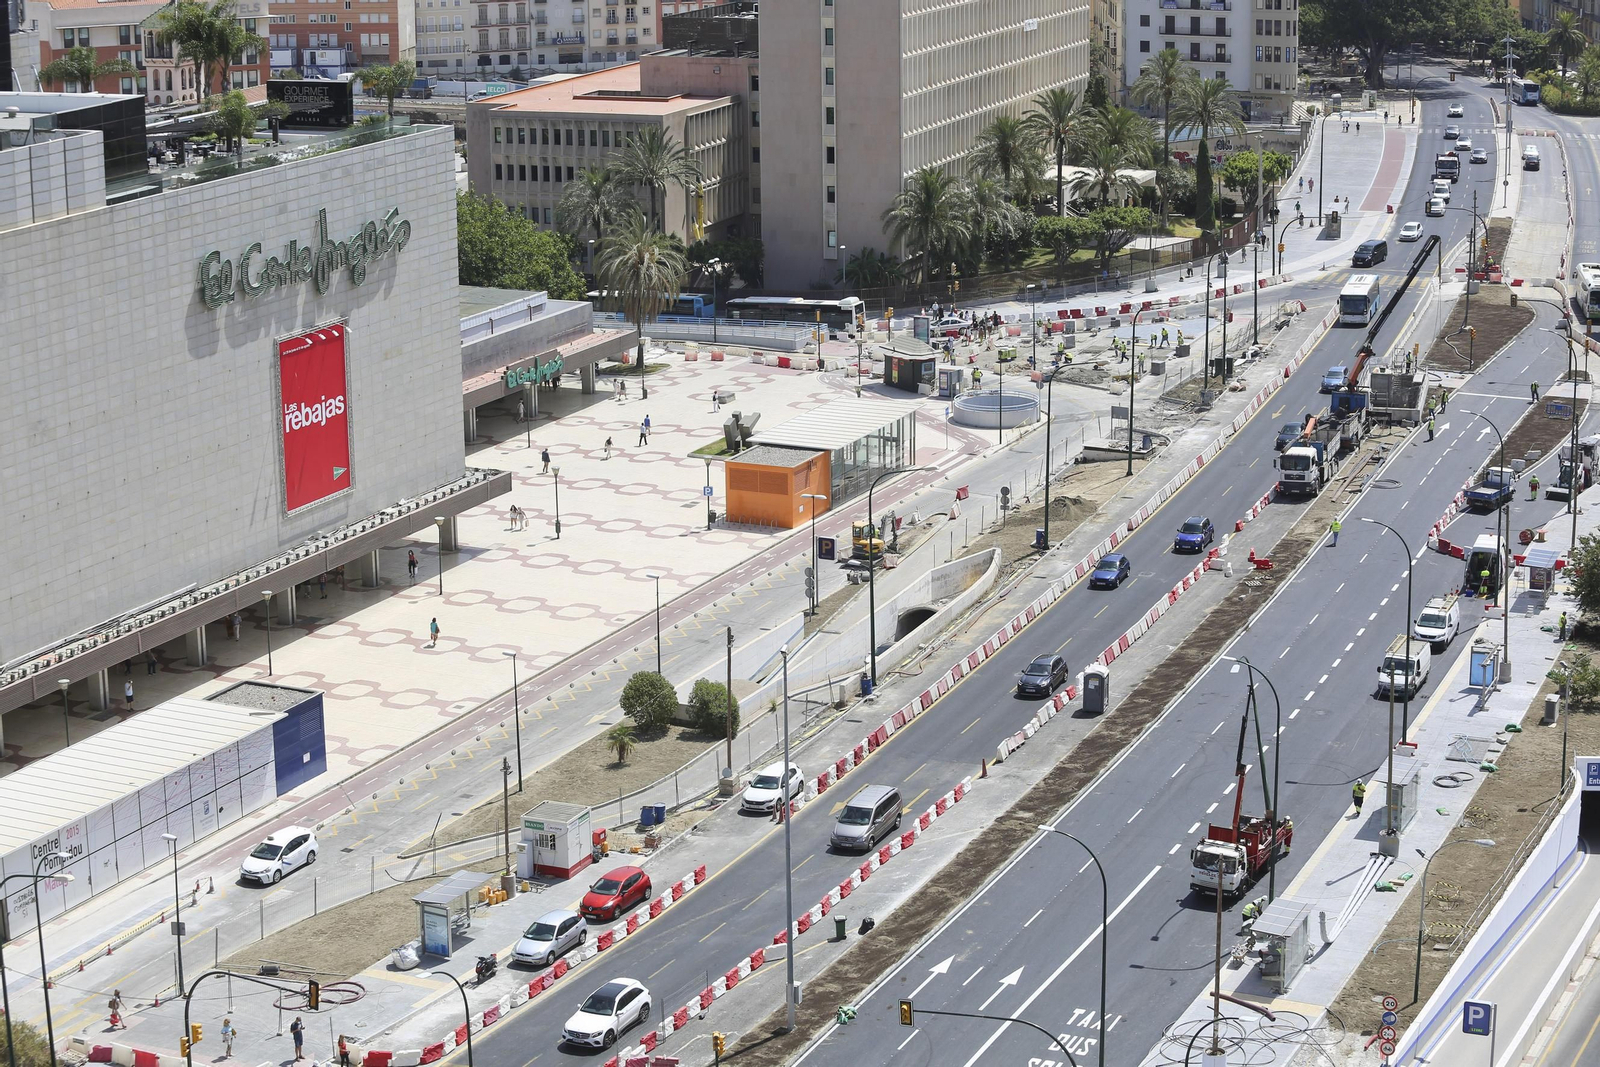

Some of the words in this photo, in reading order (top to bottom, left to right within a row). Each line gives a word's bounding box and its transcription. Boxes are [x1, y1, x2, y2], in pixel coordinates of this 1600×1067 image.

[284, 86, 329, 95] GOURMET
[284, 95, 330, 103] EXPERIENCE
[201, 250, 235, 309] El
[241, 242, 313, 298] Corte
[316, 207, 411, 296] Inglés
[516, 366, 536, 385] Corte
[536, 355, 564, 384] Inglés
[284, 403, 298, 414] Las
[285, 395, 345, 433] rebajas
[704, 487, 711, 495] P
[822, 540, 832, 554] P
[66, 825, 80, 840] 2015
[33, 837, 59, 860] Centre
[1066, 1008, 1122, 1031] TAXI
[1468, 1006, 1485, 1025] P
[1048, 1033, 1098, 1056] BUS
